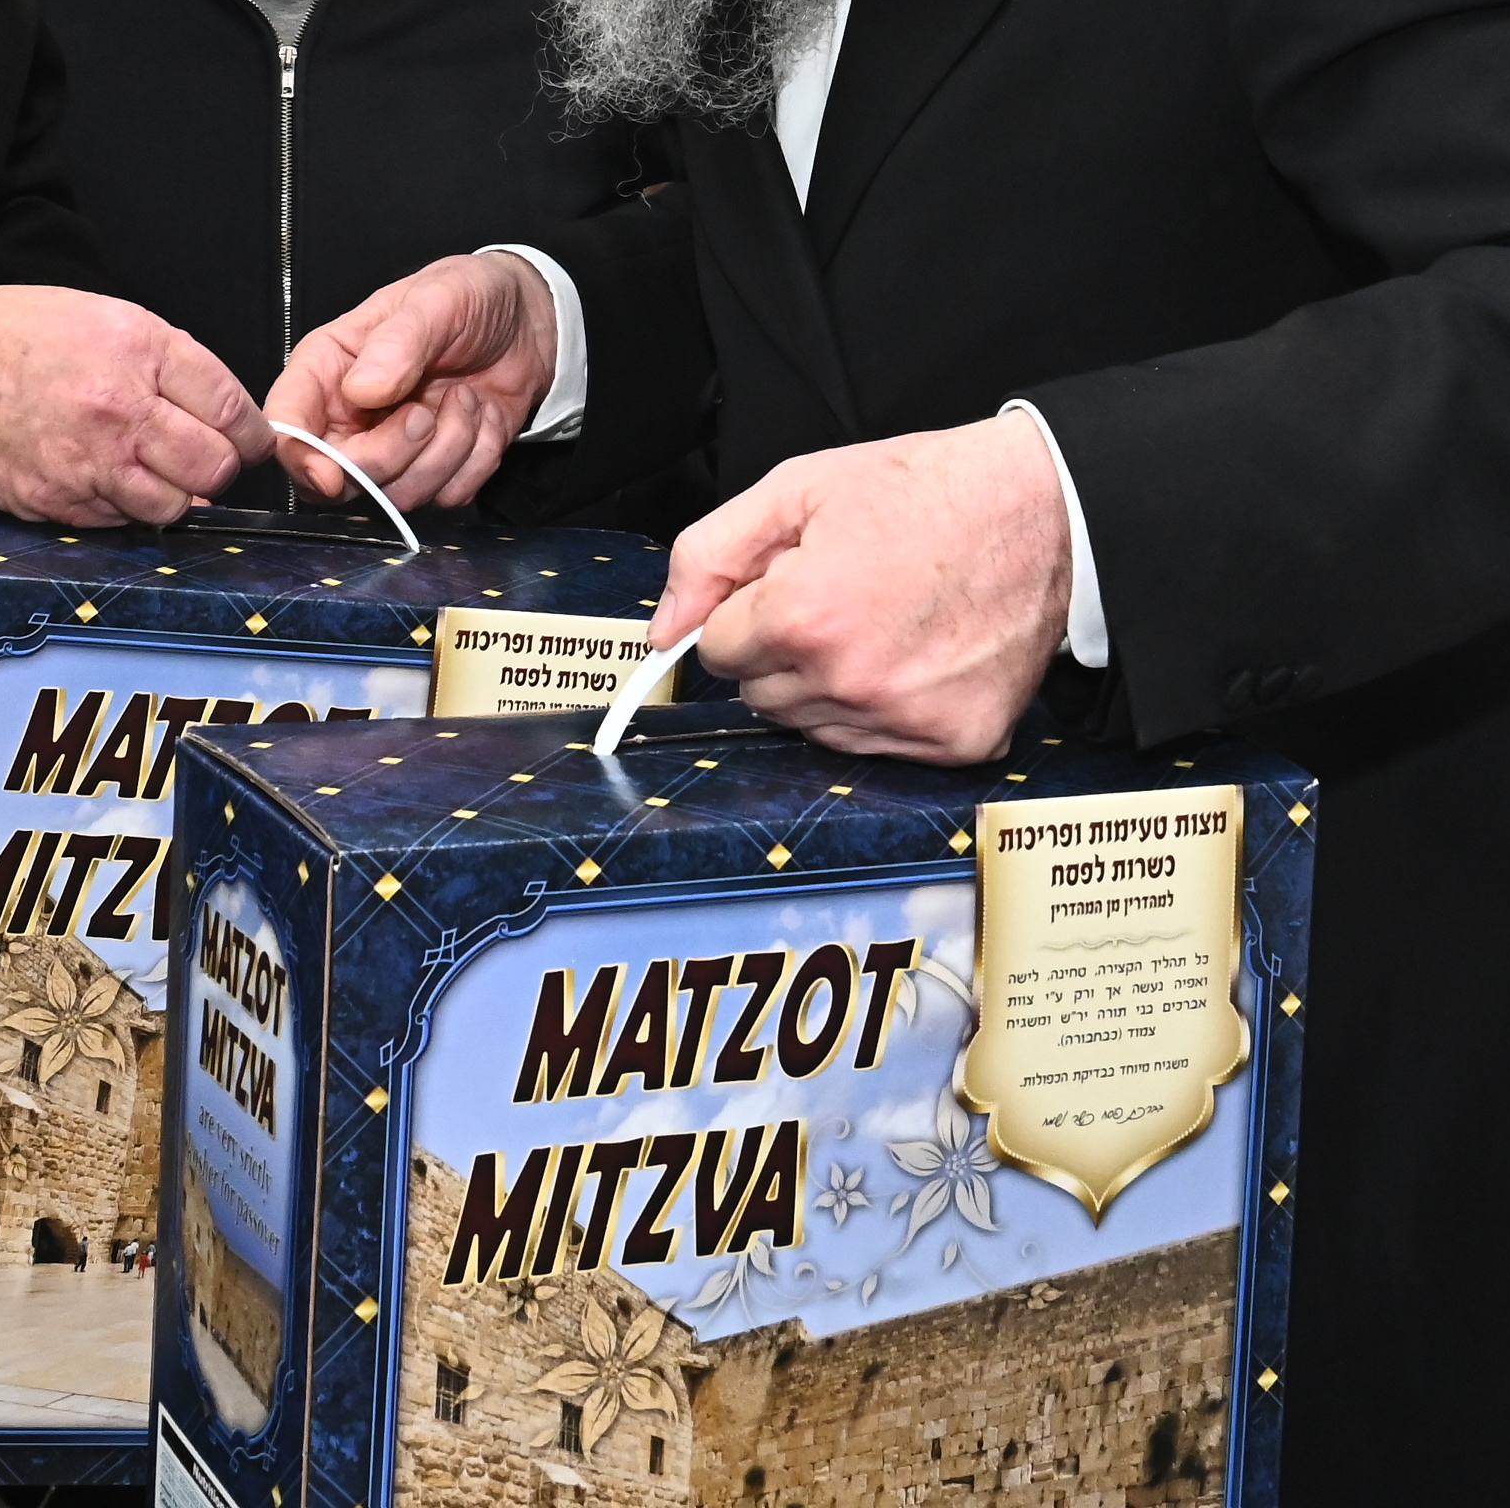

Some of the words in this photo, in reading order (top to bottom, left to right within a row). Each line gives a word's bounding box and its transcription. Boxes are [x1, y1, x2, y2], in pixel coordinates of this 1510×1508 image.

[454, 629, 533, 654] ופריכות
[538, 634, 614, 661] טעימות
[499, 662, 552, 688] לפסח
[556, 670, 618, 693] כשרות
[1088, 815, 1168, 845] טעימות
[1173, 810, 1227, 839] מצות
[997, 822, 1082, 853] ופריכות
[1050, 853, 1106, 888] לפסח
[1110, 854, 1176, 882] כשרות
[1050, 899, 1103, 923] המהדרין
[1106, 898, 1120, 919] מן
[1123, 889, 1174, 917] למהדרין
[199, 900, 288, 1040] MATZOT
[1150, 955, 1187, 973] תהליך
[1194, 952, 1210, 966] כל
[1008, 969, 1039, 985] לישה
[1132, 980, 1164, 994] נעשה
[1174, 976, 1208, 990] ואפיה
[1007, 994, 1034, 1008] צוות
[1073, 987, 1094, 1004] ורק
[1105, 985, 1122, 1000] אך
[1097, 1006, 1127, 1020] תורה
[1136, 1003, 1153, 1016] בני
[1162, 998, 1207, 1013] אברכים
[511, 935, 926, 1107] MATZOT
[1006, 1014, 1051, 1030] ומשגיח
[1127, 1025, 1156, 1038] צמוד
[199, 997, 278, 1141] MITZVA
[1072, 1066, 1115, 1084] בבדיקת
[1119, 1061, 1150, 1076] מיוחד
[1153, 1058, 1189, 1072] משגיח
[198, 1103, 215, 1133] are
[216, 1120, 239, 1168] very
[219, 1168, 235, 1208] for
[236, 1195, 281, 1256] passover
[440, 1116, 808, 1289] MITZVA
